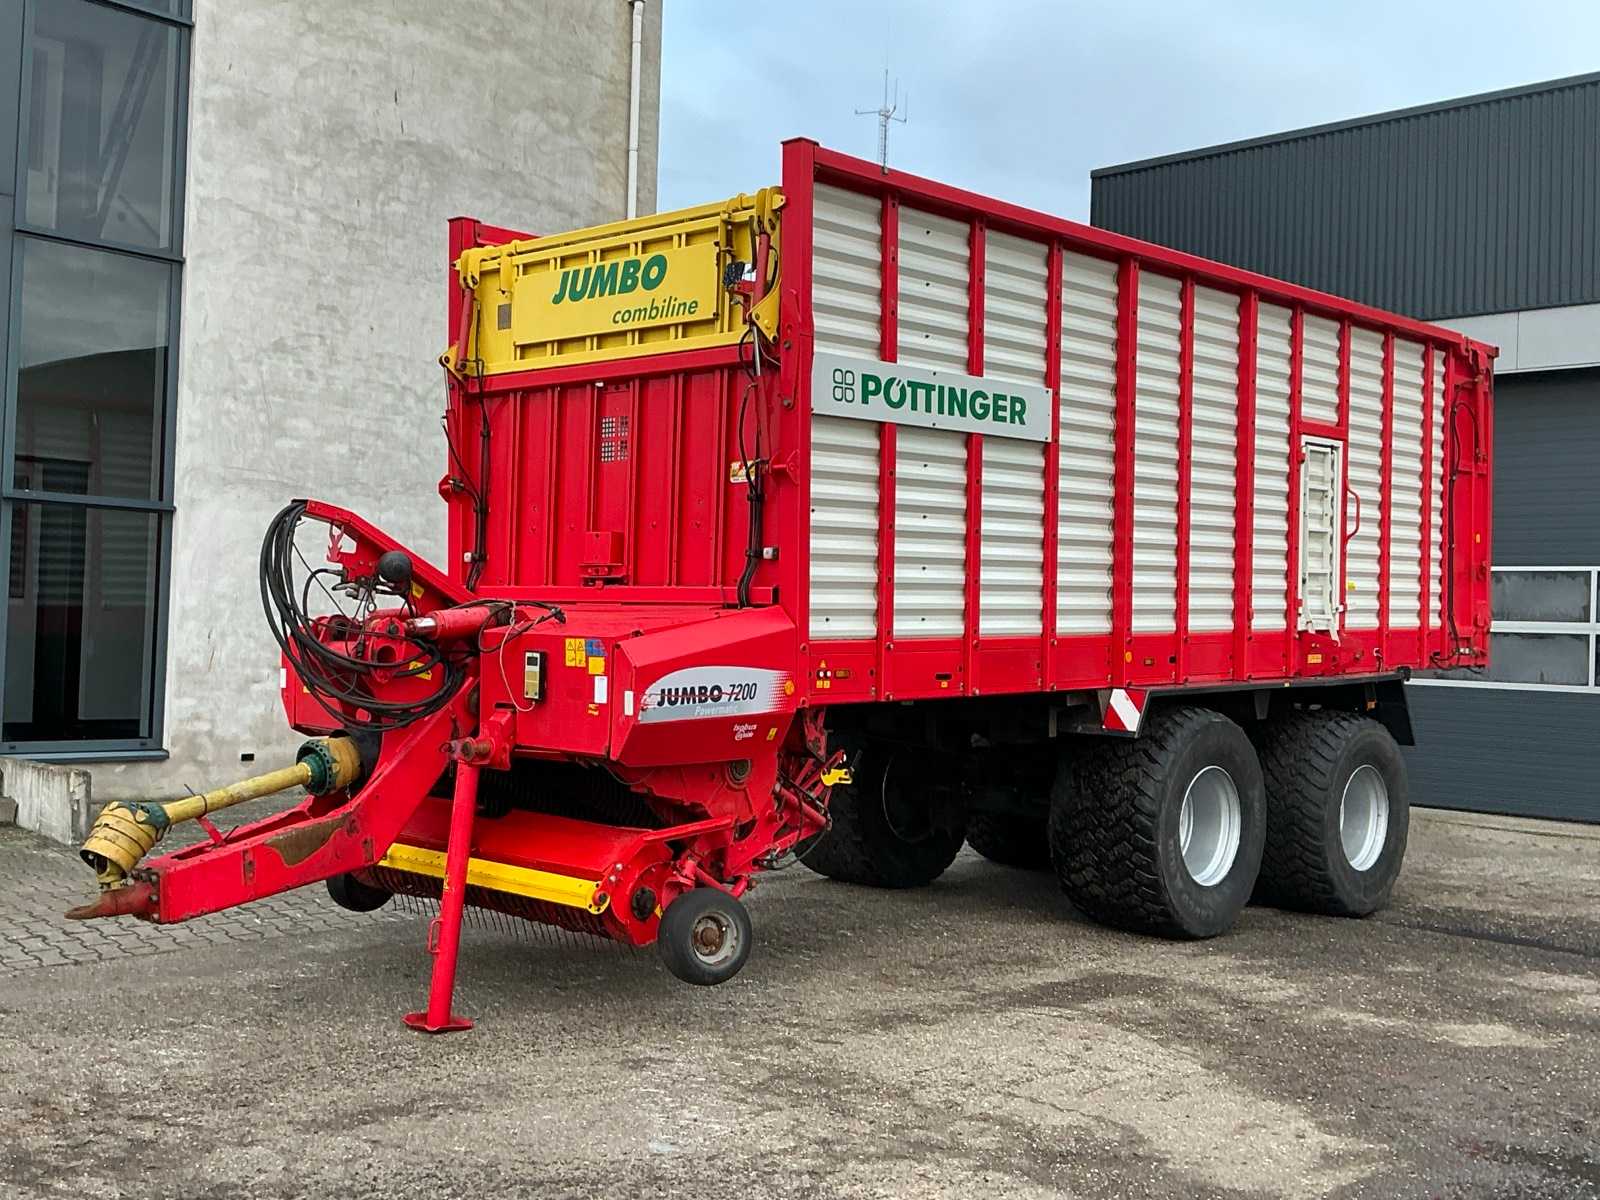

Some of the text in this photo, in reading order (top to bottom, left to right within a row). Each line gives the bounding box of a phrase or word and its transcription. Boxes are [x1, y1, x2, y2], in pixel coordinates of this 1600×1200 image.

[552, 255, 668, 305] JUMBO
[612, 296, 698, 324] combiline
[861, 373, 1027, 425] PÖTTINGER
[657, 686, 722, 707] JUMBO
[728, 683, 757, 702] 7200
